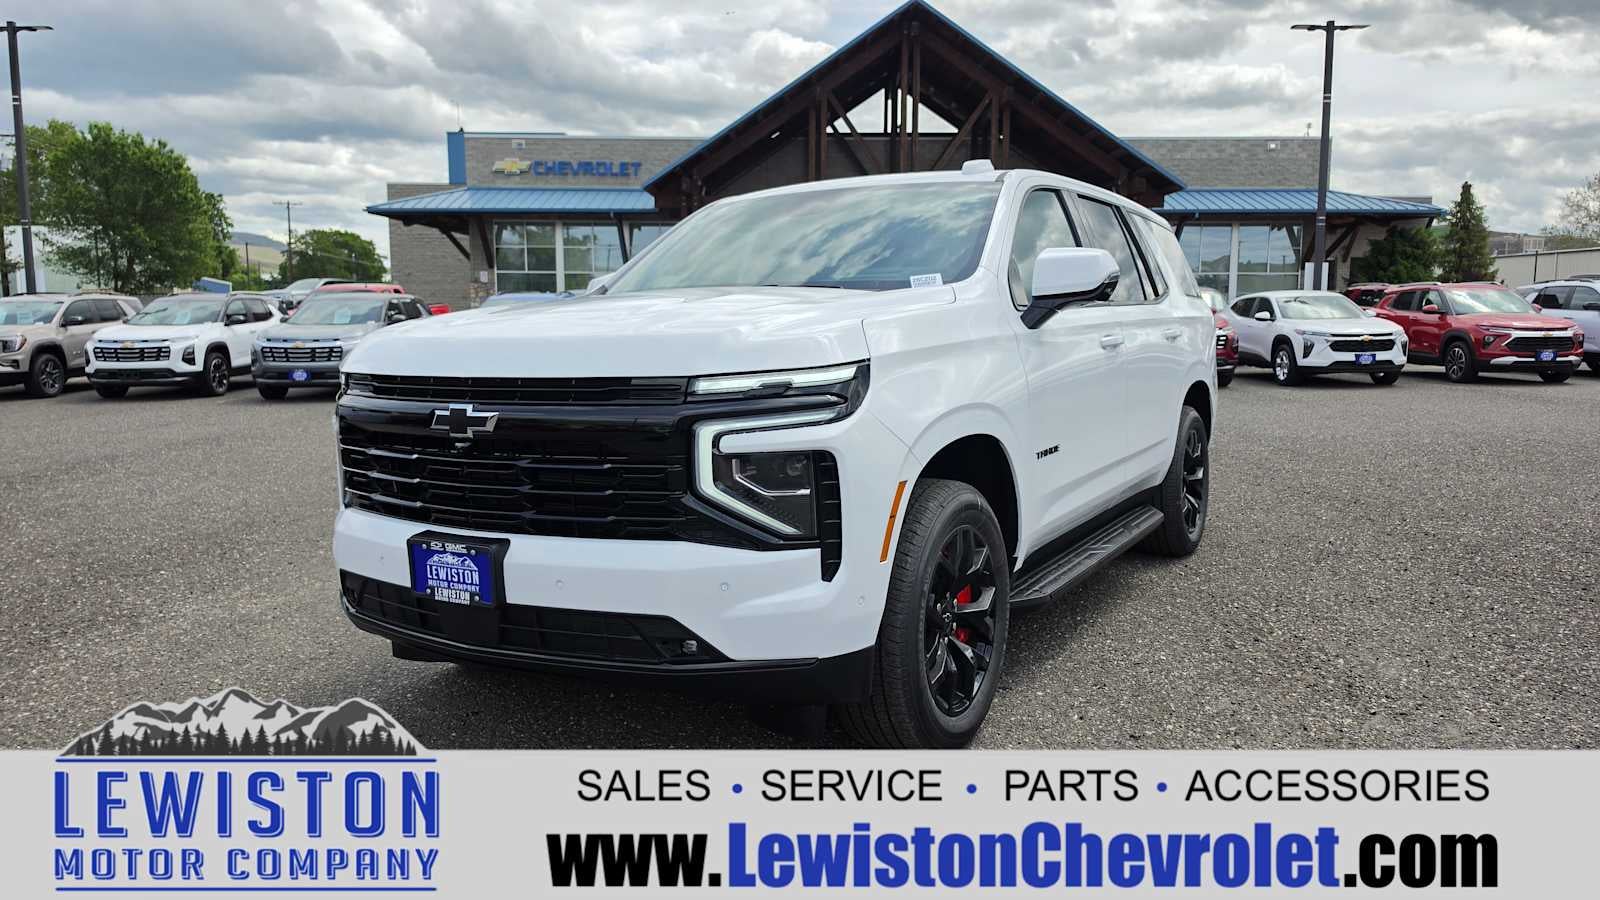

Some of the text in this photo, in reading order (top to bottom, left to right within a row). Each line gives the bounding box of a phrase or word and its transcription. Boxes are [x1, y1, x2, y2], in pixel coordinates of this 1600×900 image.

[533, 160, 641, 176] CHEVROLET
[427, 565, 480, 584] LEWISTON
[428, 579, 480, 593] MOTOR COMPANY
[434, 587, 471, 600] LEWISTON
